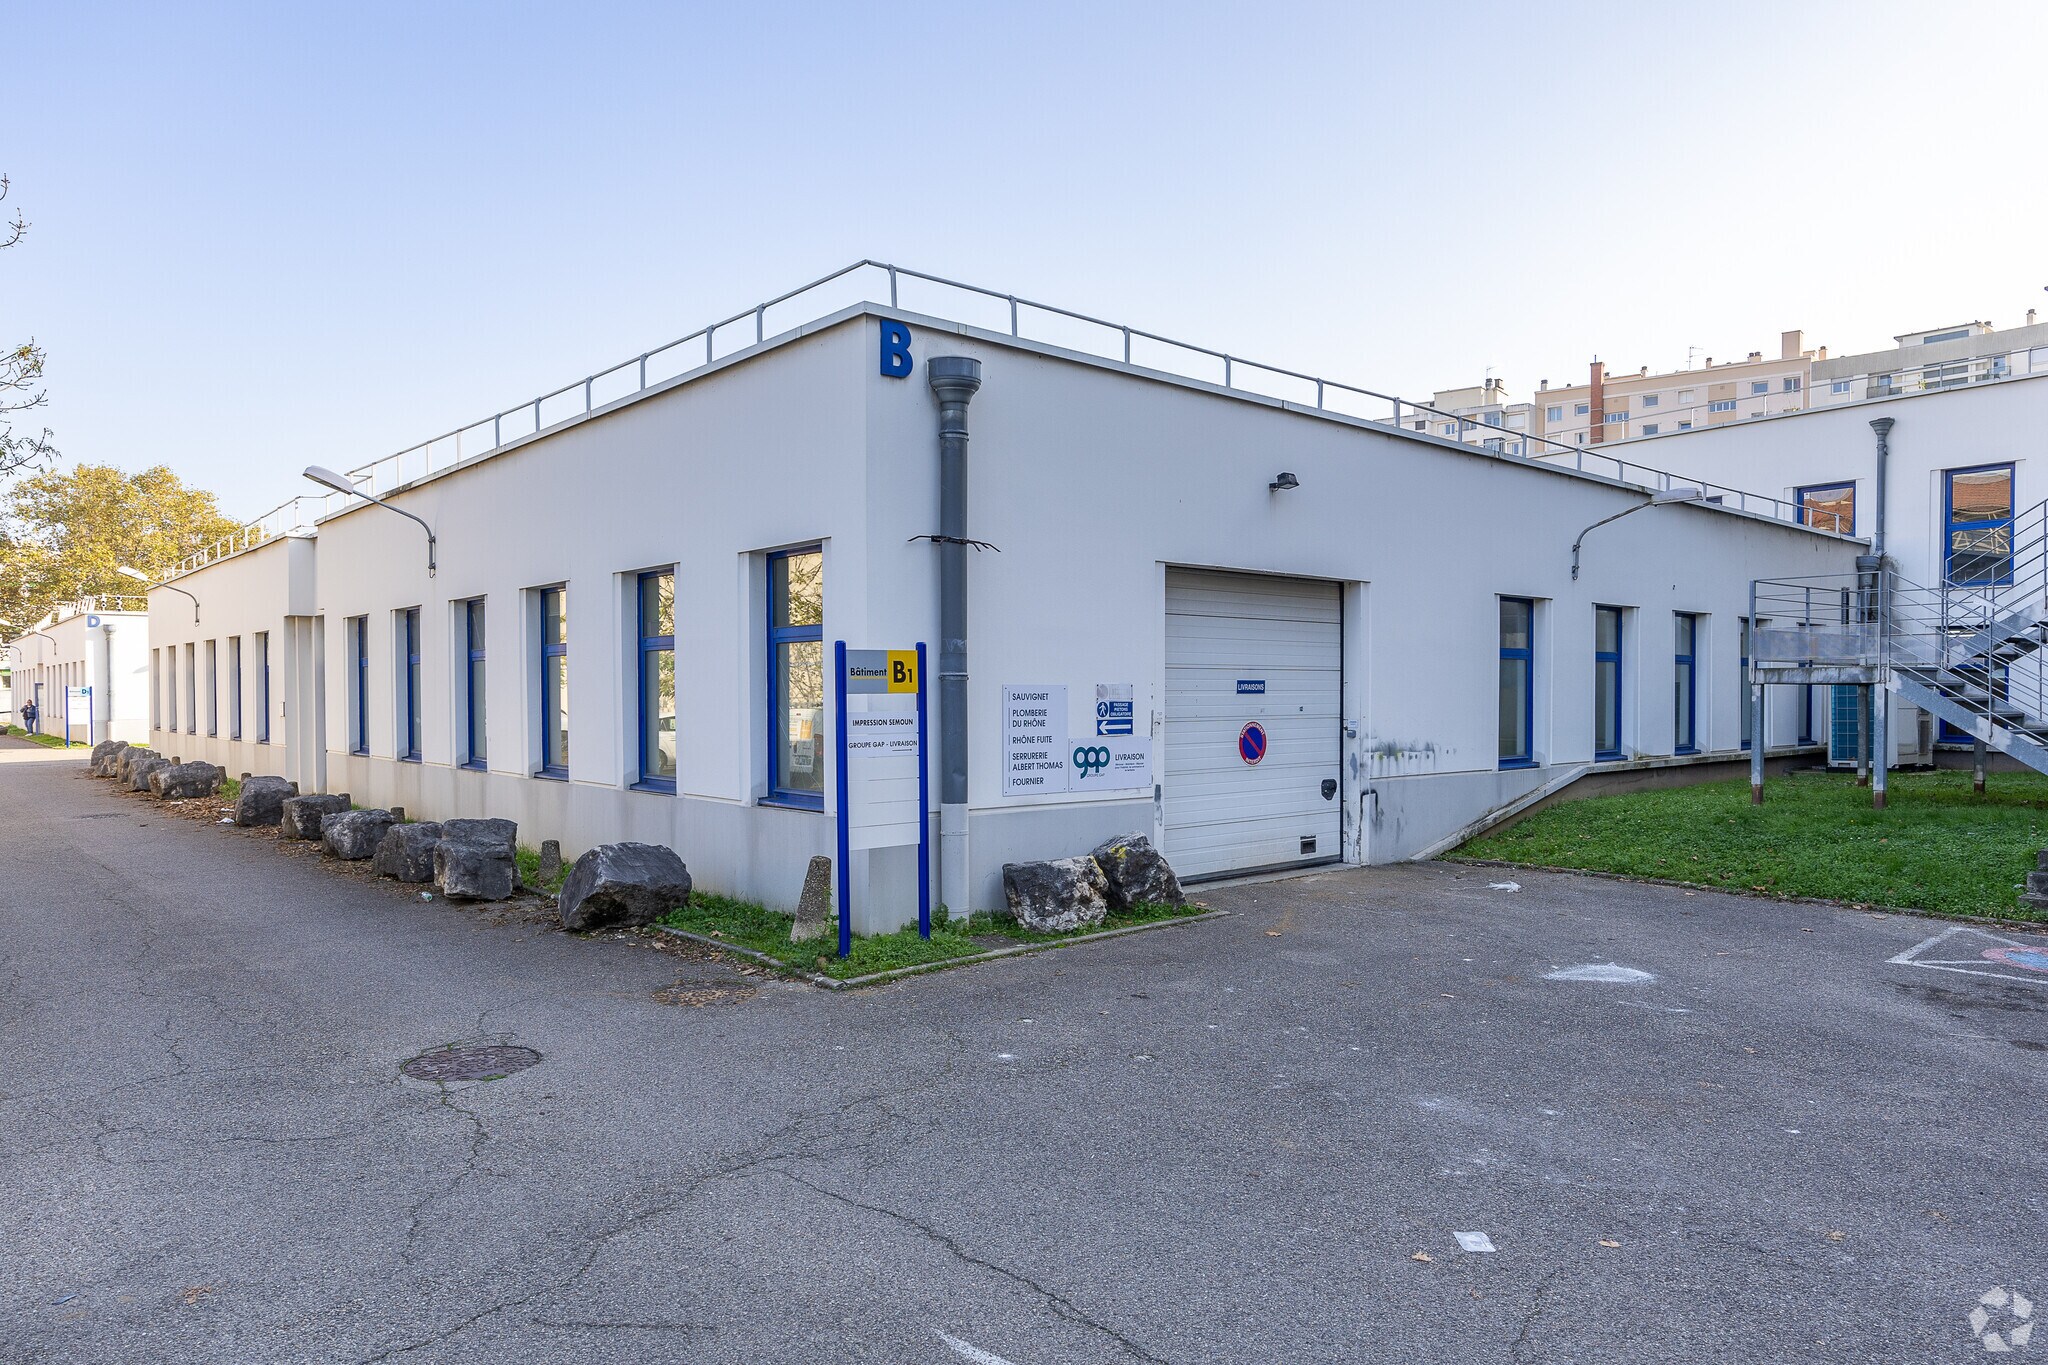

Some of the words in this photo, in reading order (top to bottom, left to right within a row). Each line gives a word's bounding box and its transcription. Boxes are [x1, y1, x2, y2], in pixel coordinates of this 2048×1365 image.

[880, 320, 913, 378] B
[87, 615, 100, 628] D
[850, 667, 887, 676] Bâtiment
[893, 661, 912, 683] B1
[1012, 693, 1049, 701] SAUVIGNET
[1012, 709, 1048, 717] PLOMBERIE
[852, 719, 888, 727] IMPRESSION
[889, 718, 913, 726] SEMOUN
[1012, 720, 1022, 728] DU
[1023, 717, 1046, 727] RHÔNE
[1012, 734, 1036, 744] RHÔNE
[1036, 735, 1053, 743] FUITE
[848, 741, 871, 749] GROUPE
[1012, 752, 1048, 760] SERRURERIE
[1115, 753, 1145, 761] LIVRAISON
[1012, 762, 1035, 771] ALBERT
[1036, 761, 1064, 770] THOMAS
[1012, 777, 1045, 786] FOURNIER
